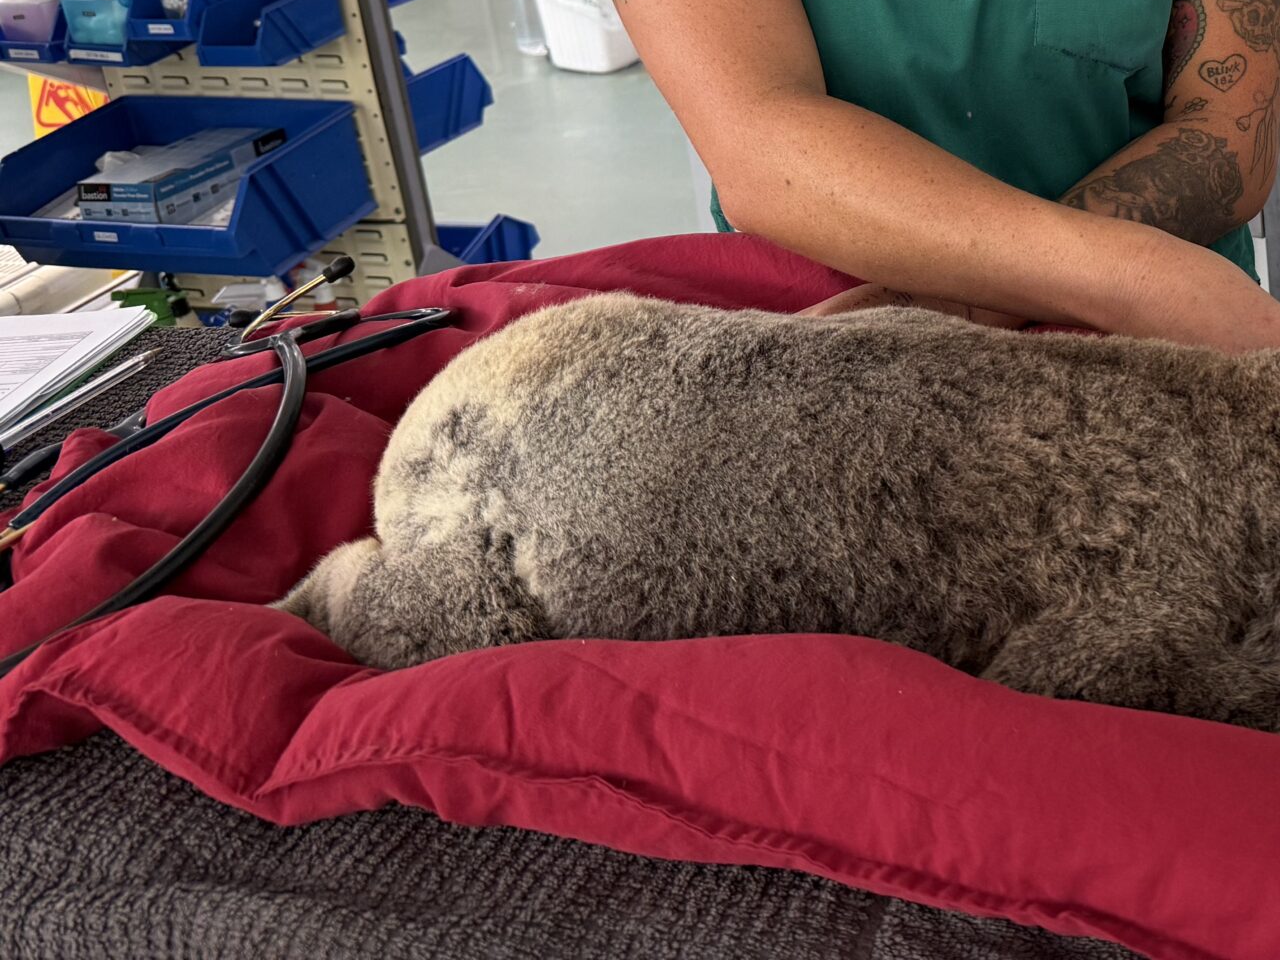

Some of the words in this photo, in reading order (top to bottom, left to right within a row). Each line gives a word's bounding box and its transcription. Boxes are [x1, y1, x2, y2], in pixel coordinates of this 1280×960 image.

[1206, 60, 1241, 79] BLINK
[1213, 74, 1234, 86] 182
[81, 184, 108, 200] bastion
